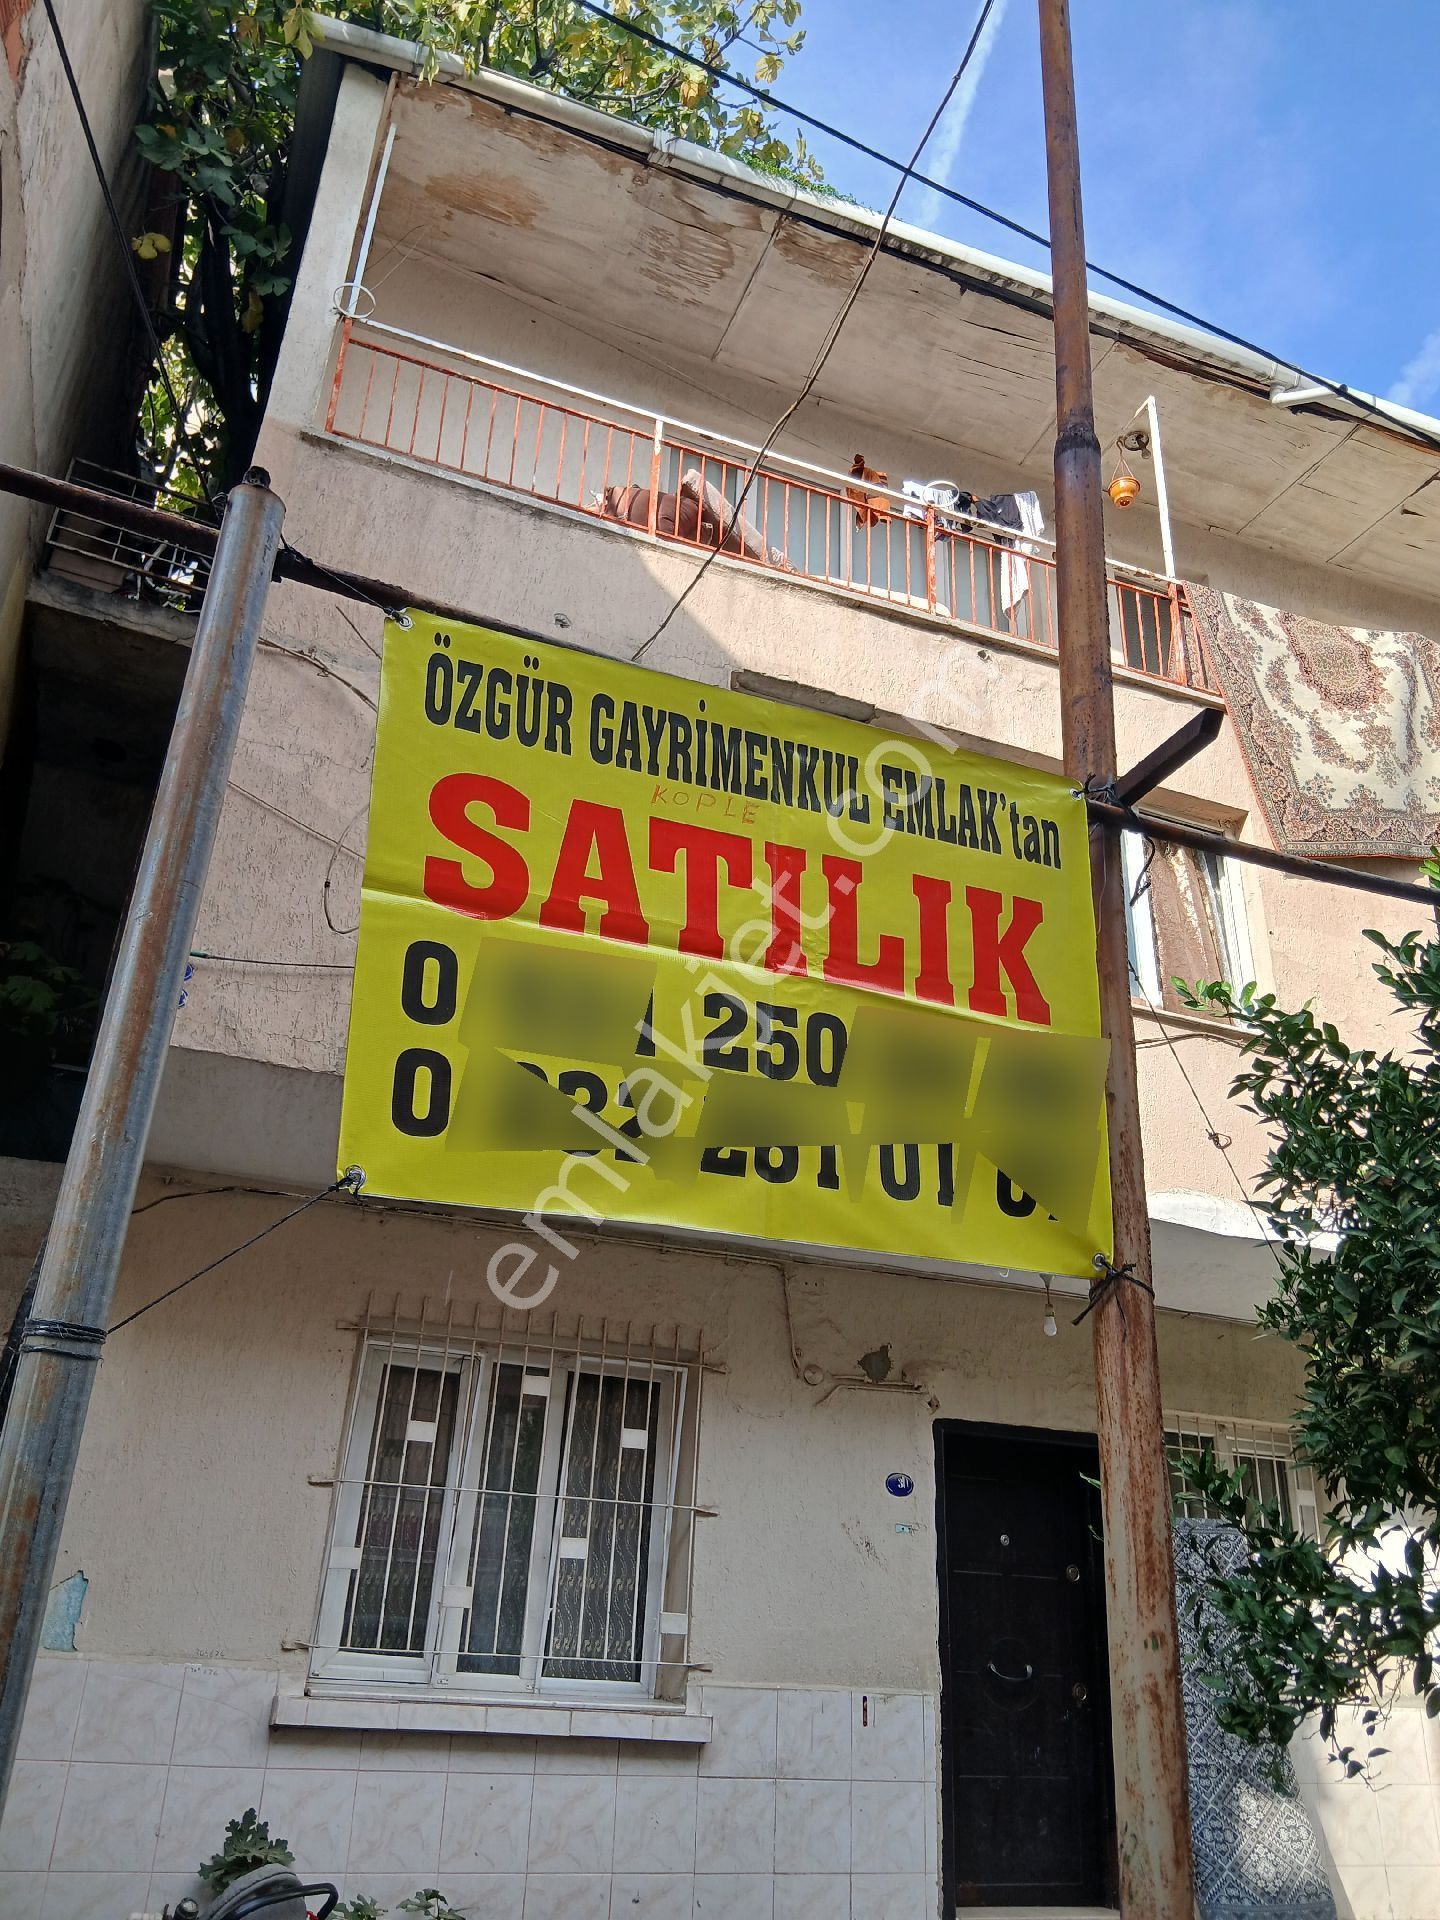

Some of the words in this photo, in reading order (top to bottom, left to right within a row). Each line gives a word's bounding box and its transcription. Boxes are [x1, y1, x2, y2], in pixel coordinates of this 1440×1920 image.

[425, 632, 573, 756] ÖZGÜR
[589, 699, 870, 824] GAYRİMENKUL
[881, 764, 1062, 870] EMLAK'tan
[422, 772, 1052, 1027] SATILIK
[391, 1047, 453, 1138] 0
[402, 939, 459, 1026] 0
[703, 992, 848, 1088] 250
